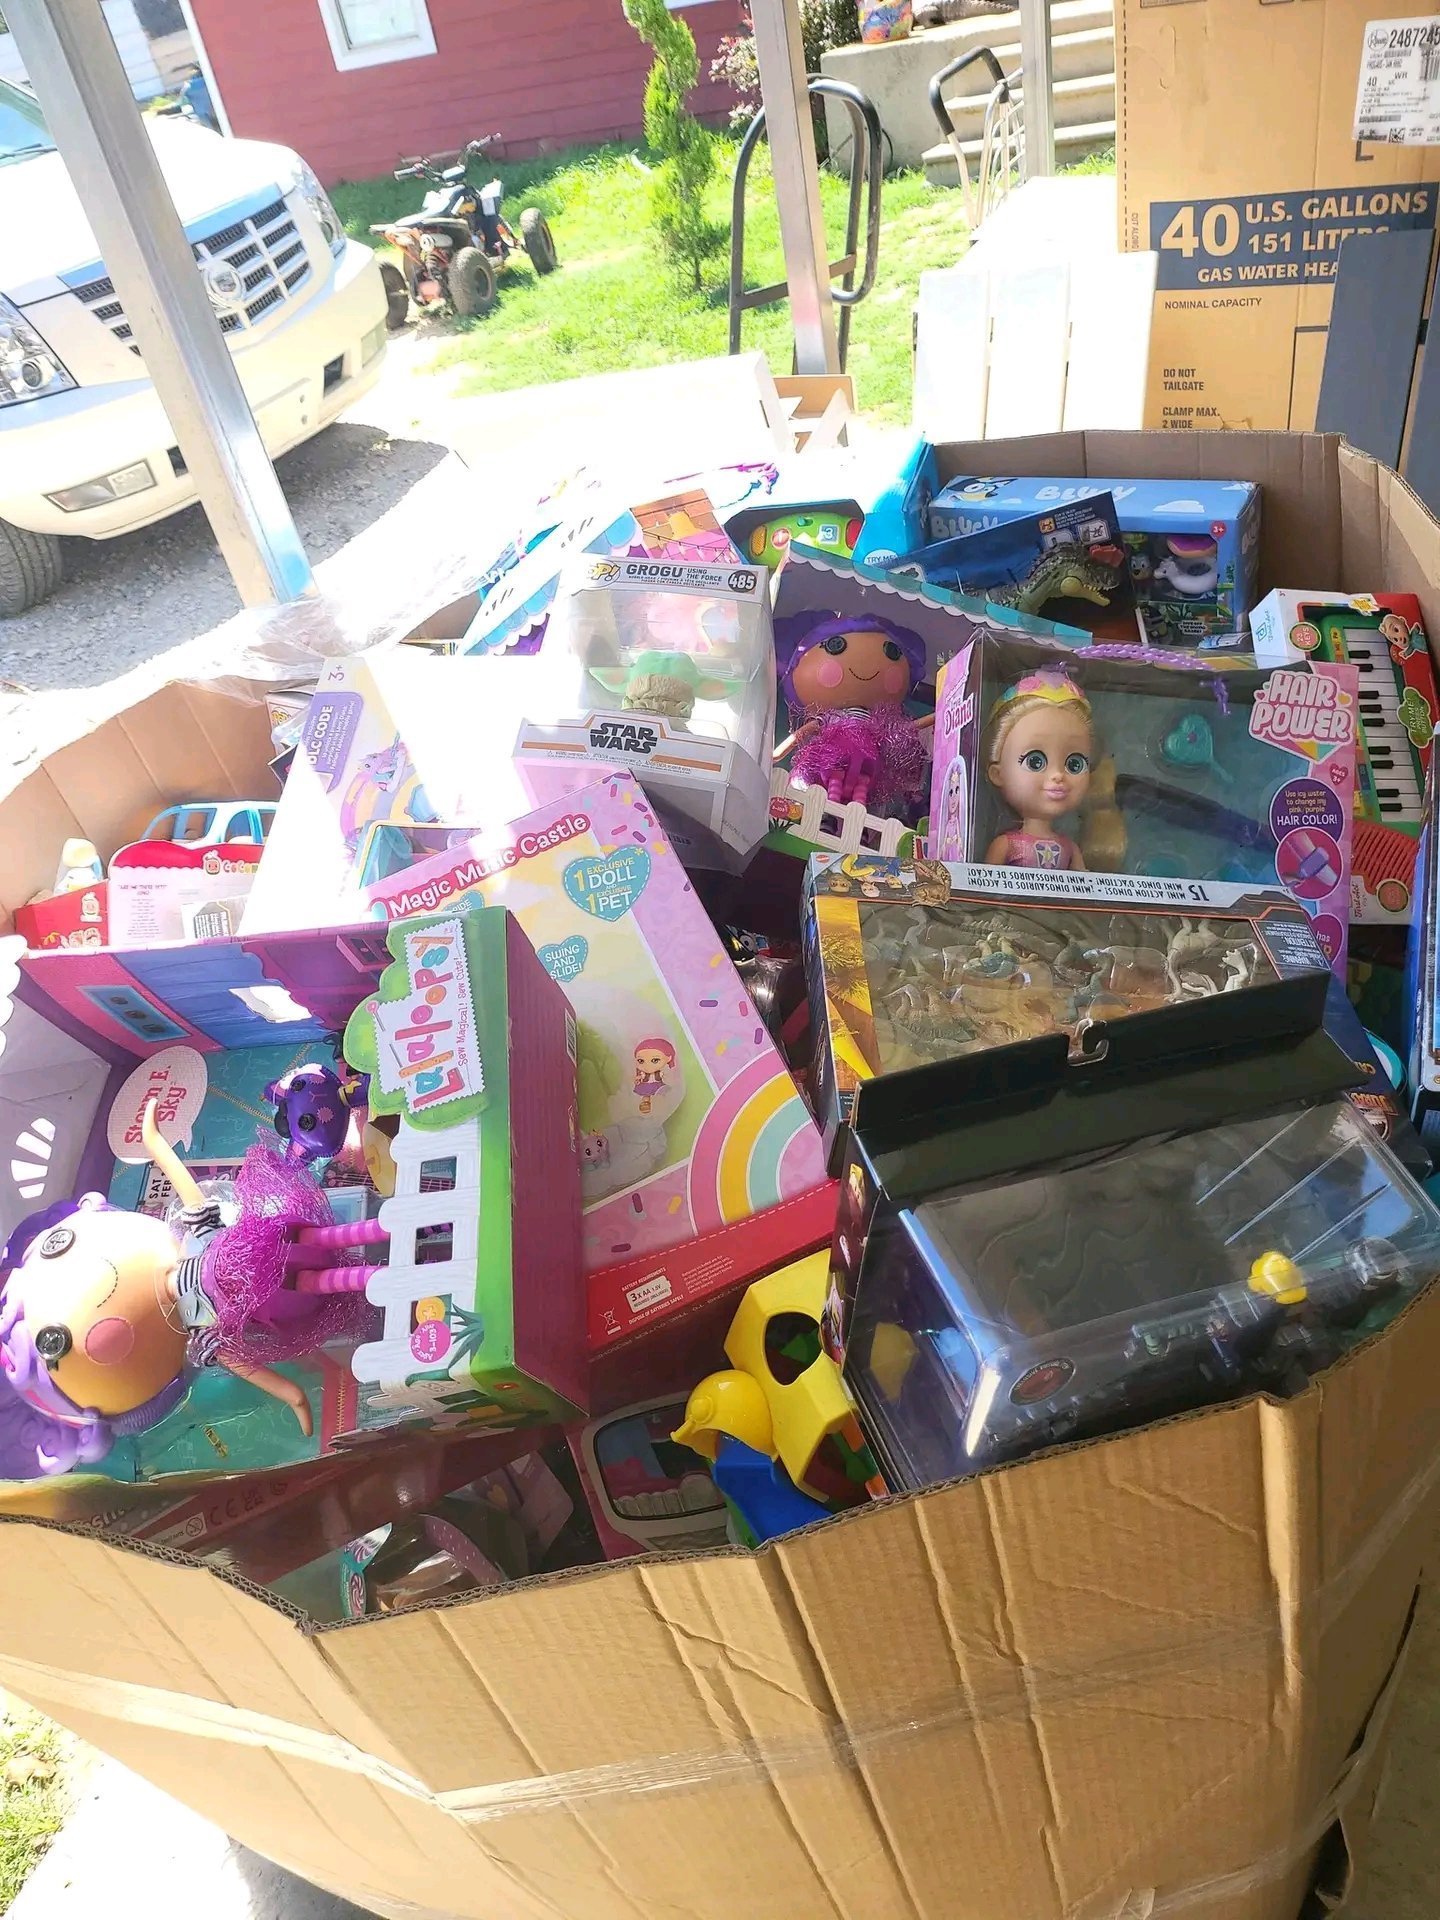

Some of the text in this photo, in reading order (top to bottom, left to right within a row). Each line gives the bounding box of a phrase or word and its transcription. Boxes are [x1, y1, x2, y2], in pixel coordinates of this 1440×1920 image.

[1246, 191, 1428, 224] U.S. GALLONS
[1160, 204, 1240, 258] 40
[1248, 226, 1390, 254] 151 LIT
[1198, 262, 1338, 283] GAS WATER HEA
[1165, 297, 1262, 310] NOMINAL CAPACITY
[1163, 368, 1196, 378] DO NOT
[1163, 381, 1204, 391] TAILGATE
[1162, 406, 1220, 416] CLAMP MAX.
[1162, 420, 1193, 428] 2 WIDE
[824, 527, 834, 540] 3
[1212, 525, 1224, 534] 3+
[626, 564, 683, 578] GROGU
[701, 574, 723, 582] FORCE
[729, 575, 756, 589] 485
[328, 665, 345, 681] 3+
[1270, 673, 1336, 707] HAIR
[314, 705, 334, 739] CODE
[945, 699, 971, 735] Diana
[1252, 703, 1349, 740] POWER
[590, 722, 657, 741] STAR
[590, 735, 657, 753] WARS
[1332, 768, 1345, 777] AGES
[1285, 790, 1297, 798] Use
[1295, 799, 1316, 807] change
[1277, 814, 1338, 826] HAIR COLOR!
[389, 879, 451, 917] Magic
[519, 816, 587, 855] Castle
[587, 857, 634, 874] EXCLUSIVE
[574, 866, 636, 891] 1 DOLL
[996, 870, 1007, 879] DE
[1009, 871, 1064, 882] DINOSSAUROS
[1067, 874, 1085, 884] MINI
[1003, 880, 1013, 889] DE
[1016, 881, 1070, 893] DINOSAURIOS
[1096, 877, 1135, 888] D'ACTION!
[1137, 880, 1161, 890] DINOS
[1164, 882, 1183, 890] MINI
[597, 885, 631, 897] EXCLUSIVE
[1105, 887, 1133, 897] DINOS!
[1136, 889, 1163, 899] ACTION
[1168, 891, 1186, 900] MINI
[1188, 884, 1210, 901] 15
[586, 891, 632, 913] 1 PET
[1316, 931, 1331, 943] has
[545, 944, 580, 962] SWING
[554, 955, 575, 969] AND
[550, 962, 582, 979] SLIDE!
[453, 956, 469, 1067] Sew Magical! Sew Cute!
[395, 936, 465, 1109] Lalaloopsy
[149, 1065, 171, 1081] E.
[157, 1087, 187, 1122] Sky
[1350, 1092, 1386, 1109] JURAS
[149, 1177, 160, 1199] SAT
[621, 1267, 666, 1292] BATTERY REQUIREMENTS
[642, 1289, 651, 1297] AA
[628, 1312, 645, 1325] DISPOSE
[650, 1301, 670, 1314] BATTERIES
[670, 1294, 684, 1304] SAFELY
